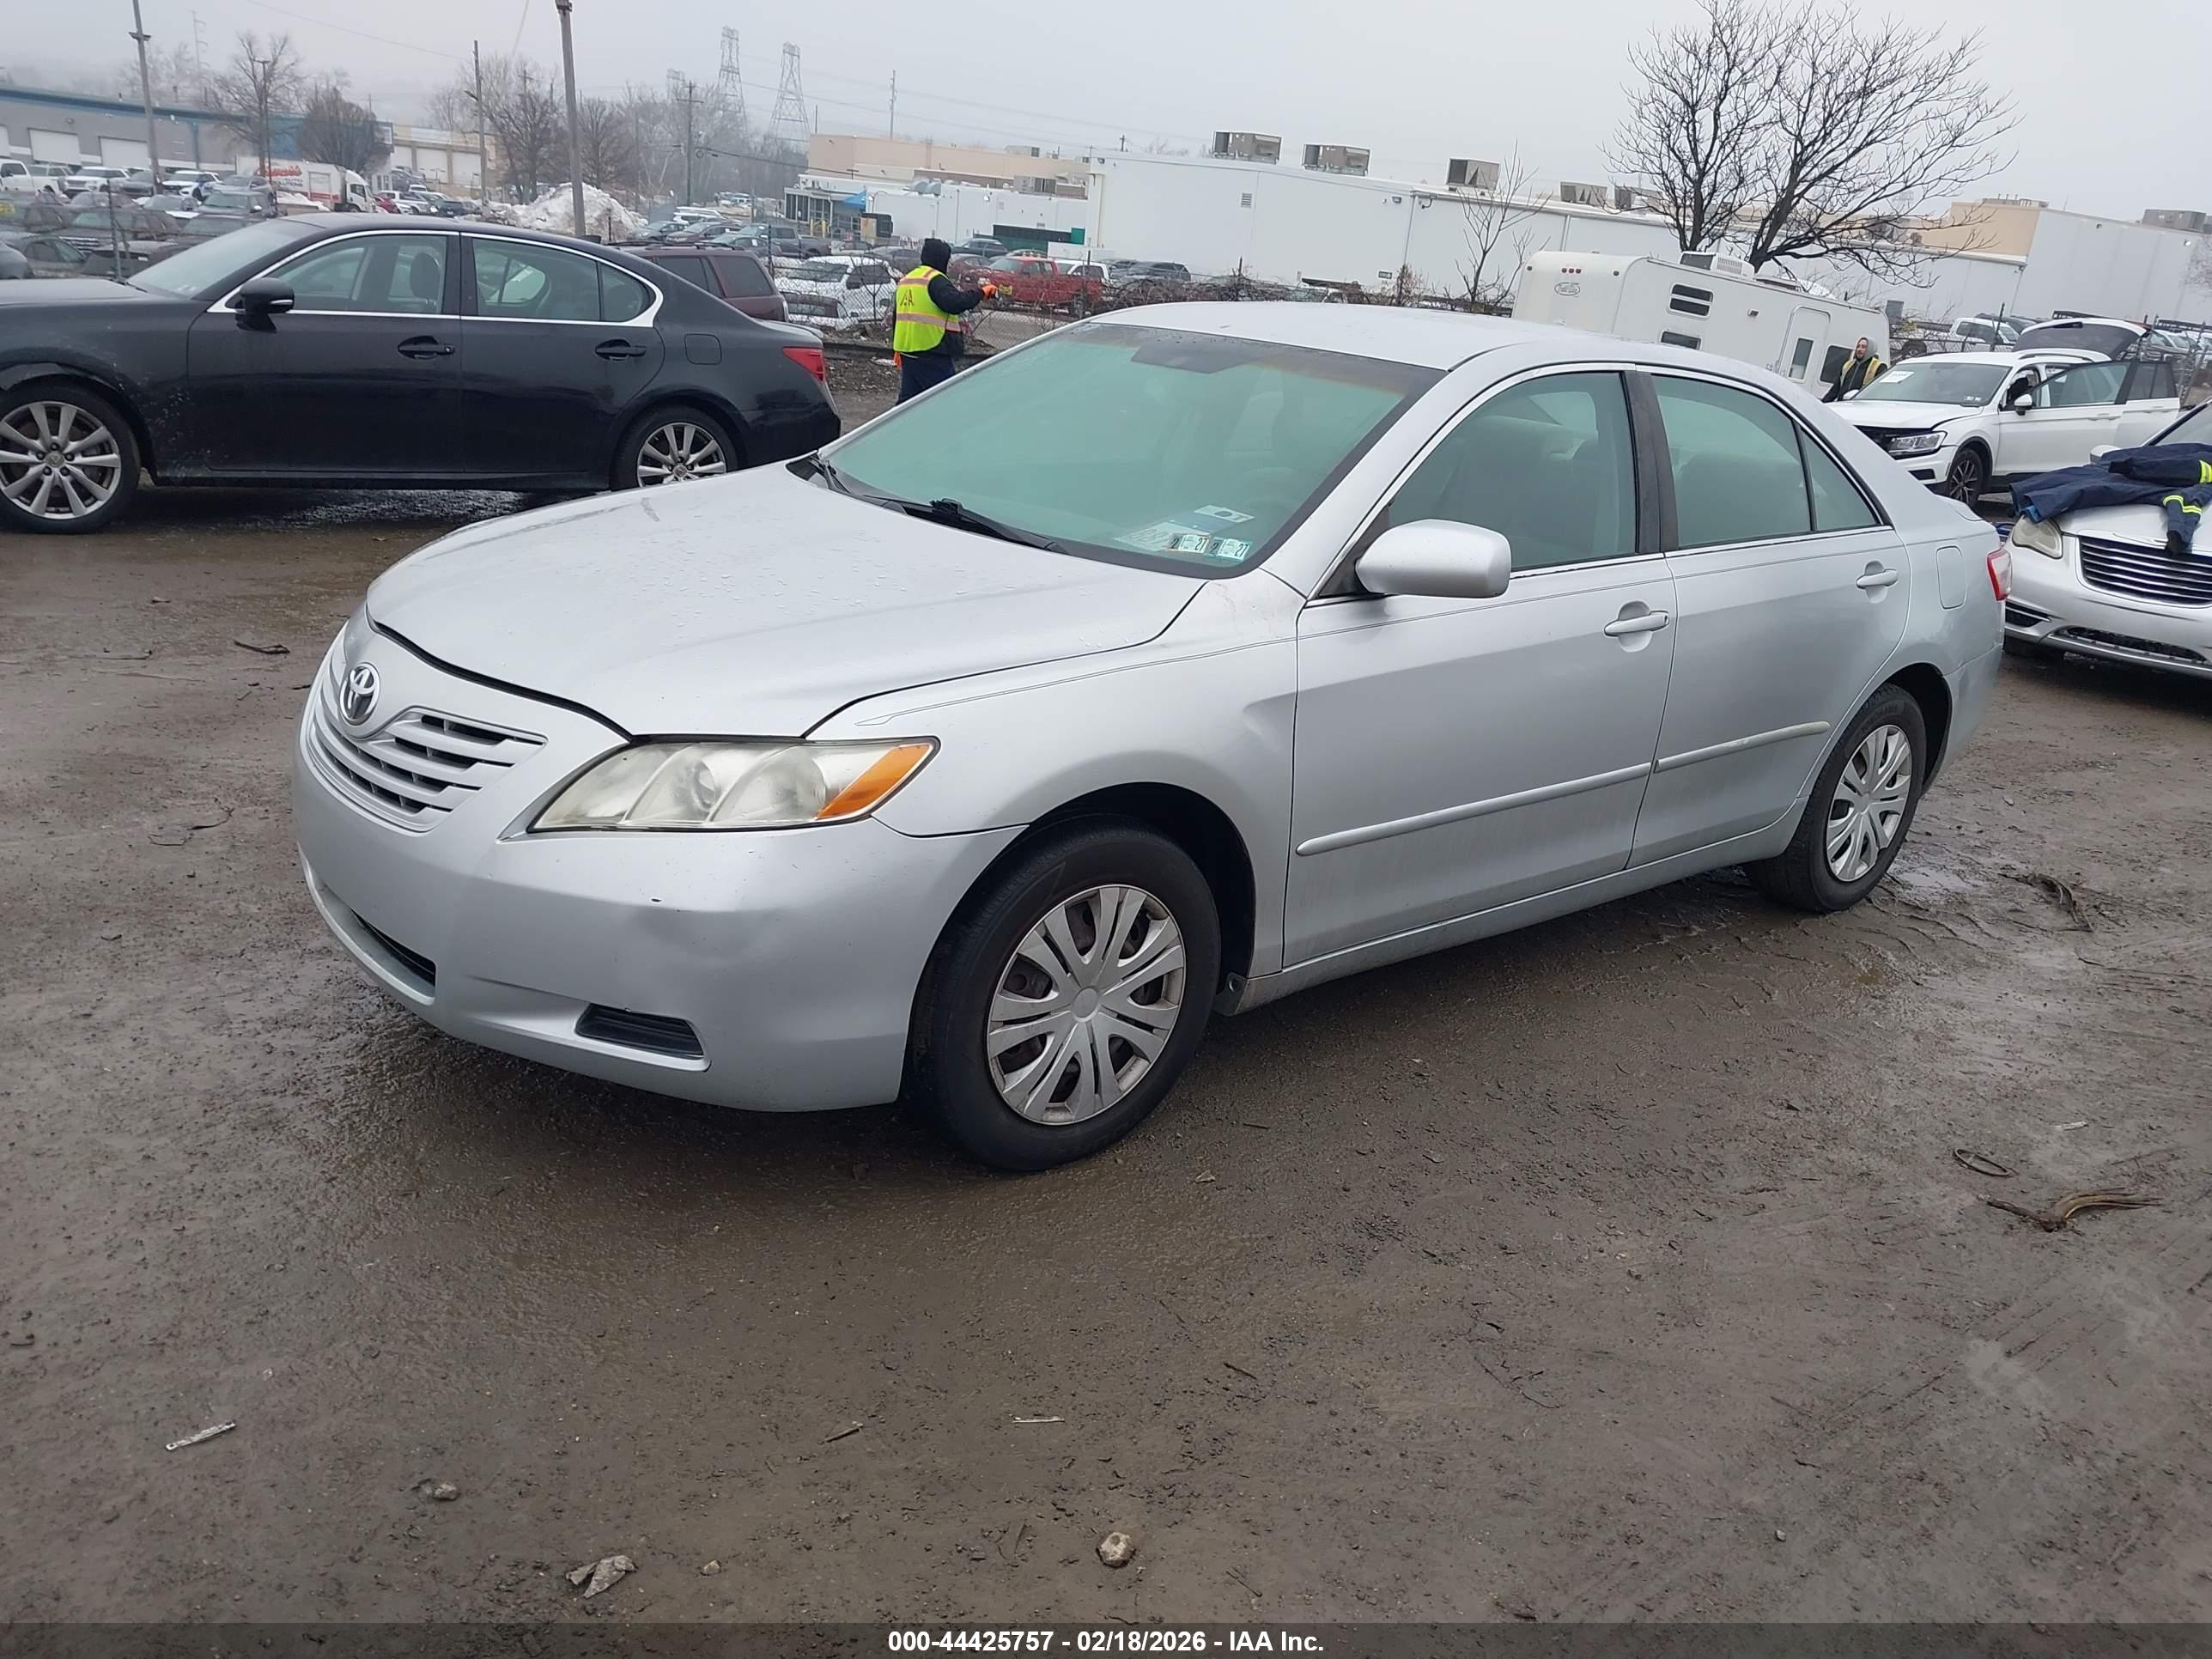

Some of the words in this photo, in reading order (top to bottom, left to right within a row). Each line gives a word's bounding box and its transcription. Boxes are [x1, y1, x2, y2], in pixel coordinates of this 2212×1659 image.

[1170, 538, 1180, 550] 2
[1194, 538, 1207, 550] 27
[1235, 543, 1249, 558] 27
